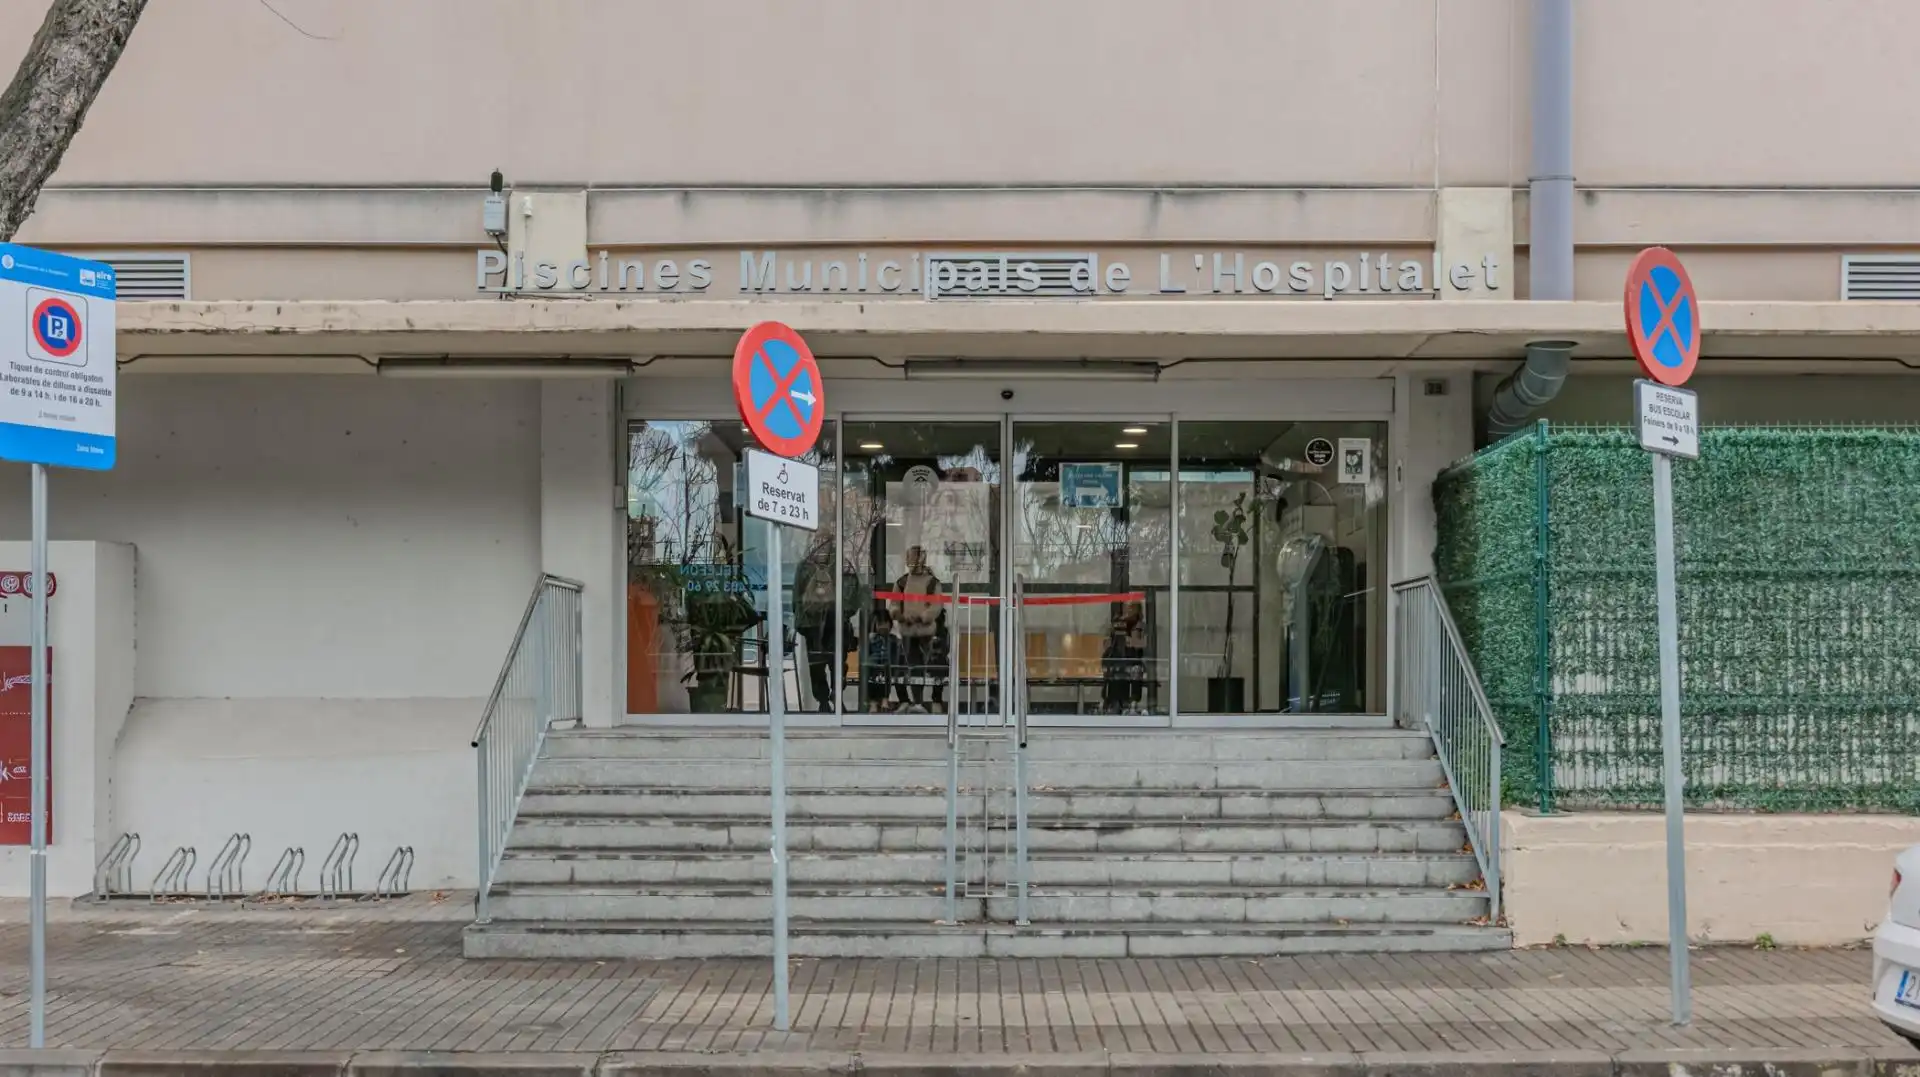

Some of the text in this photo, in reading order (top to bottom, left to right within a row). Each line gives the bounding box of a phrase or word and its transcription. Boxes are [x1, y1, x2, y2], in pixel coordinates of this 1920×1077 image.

[476, 250, 1499, 300] Piscines Municipals de L'Hospitalet
[10, 361, 33, 373] Tiquet
[34, 365, 43, 374] de
[42, 379, 52, 389] de
[10, 387, 21, 396] de
[21, 388, 26, 397] 9
[35, 389, 43, 399] 14
[1656, 391, 1683, 405] RESERVA
[1648, 404, 1691, 421] BUS ESCOLAR
[762, 481, 805, 503] Reservat
[758, 498, 809, 520] de 7 a 23 h
